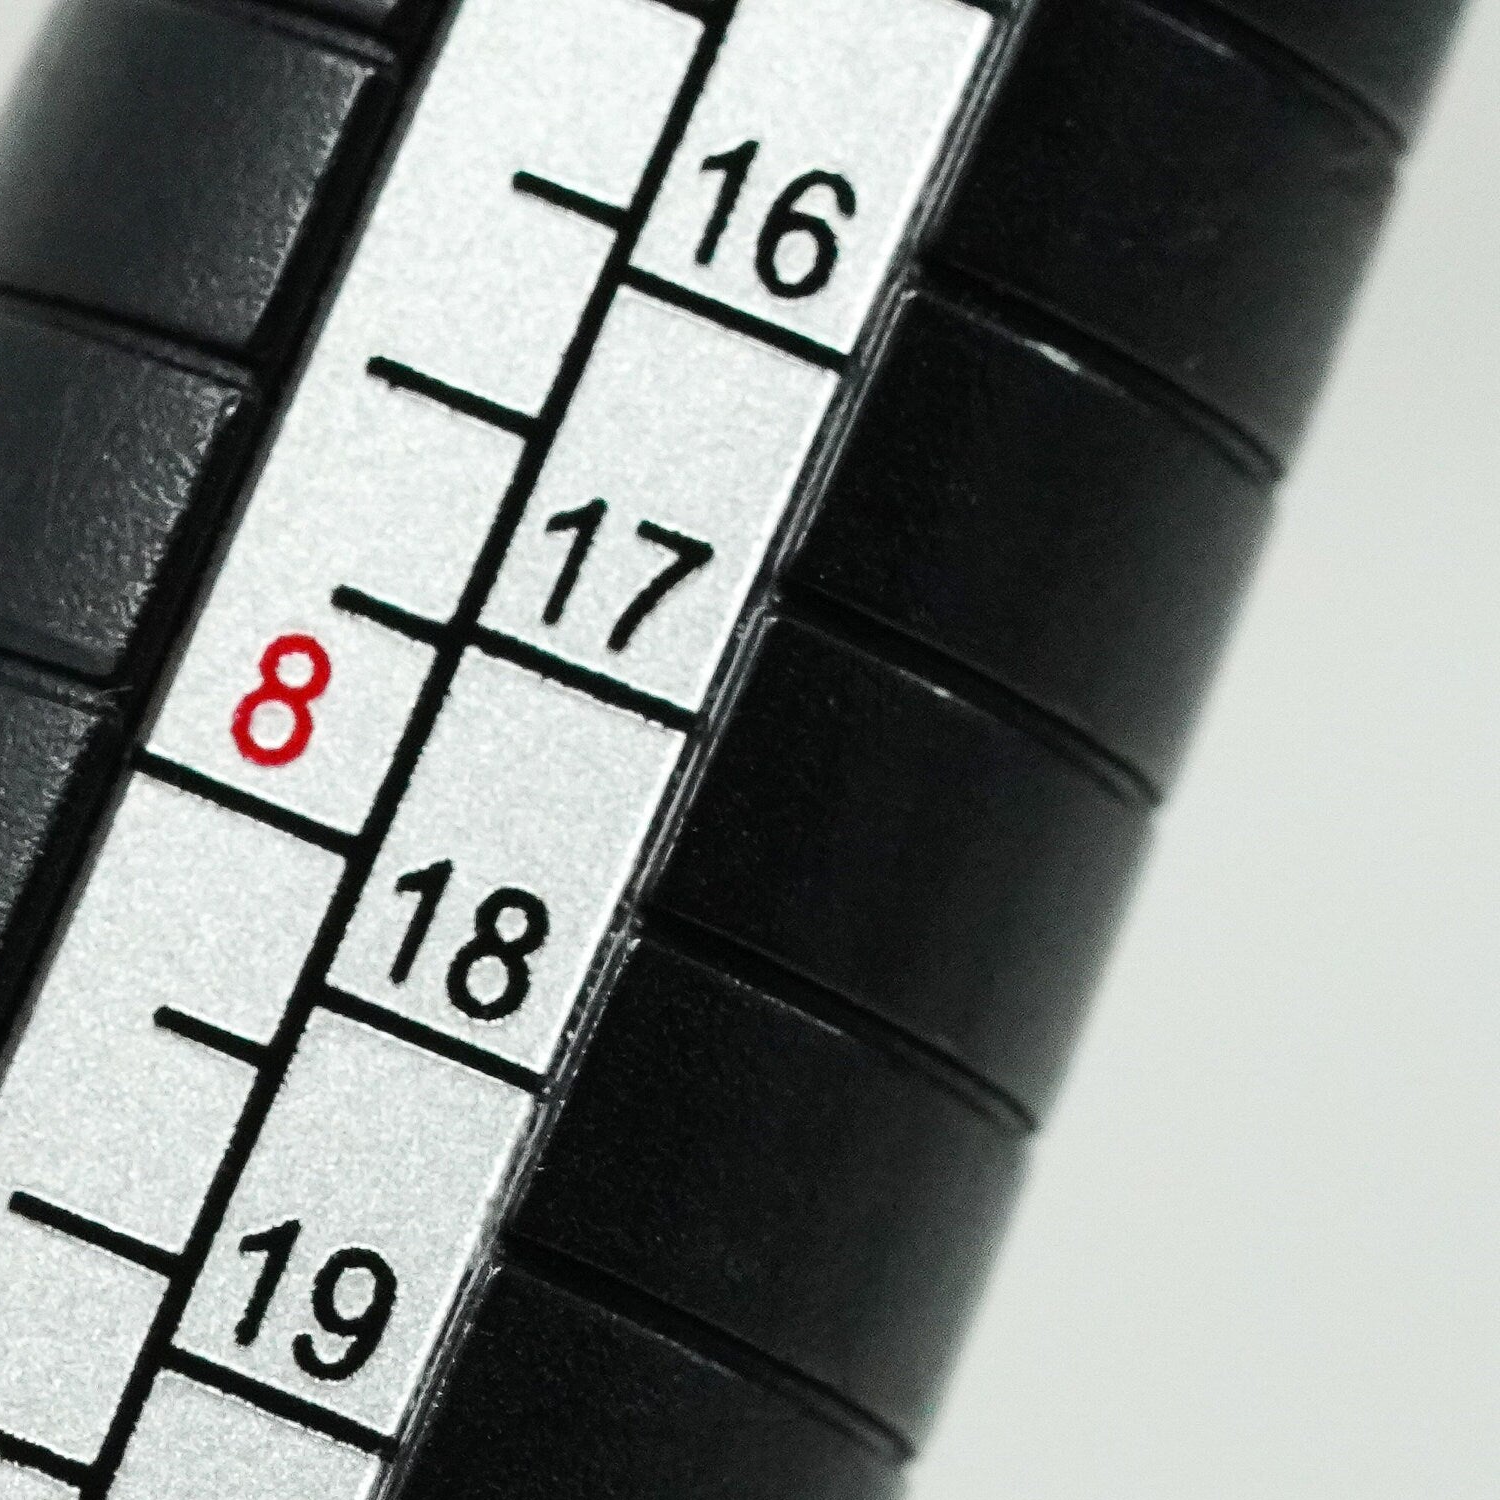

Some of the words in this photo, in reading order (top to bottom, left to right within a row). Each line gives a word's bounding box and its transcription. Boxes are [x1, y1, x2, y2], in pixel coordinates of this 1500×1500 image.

[694, 140, 857, 300] 16
[541, 499, 715, 654] 17
[230, 634, 332, 767] 8
[388, 859, 550, 1022] 18
[234, 1219, 398, 1382] 19
